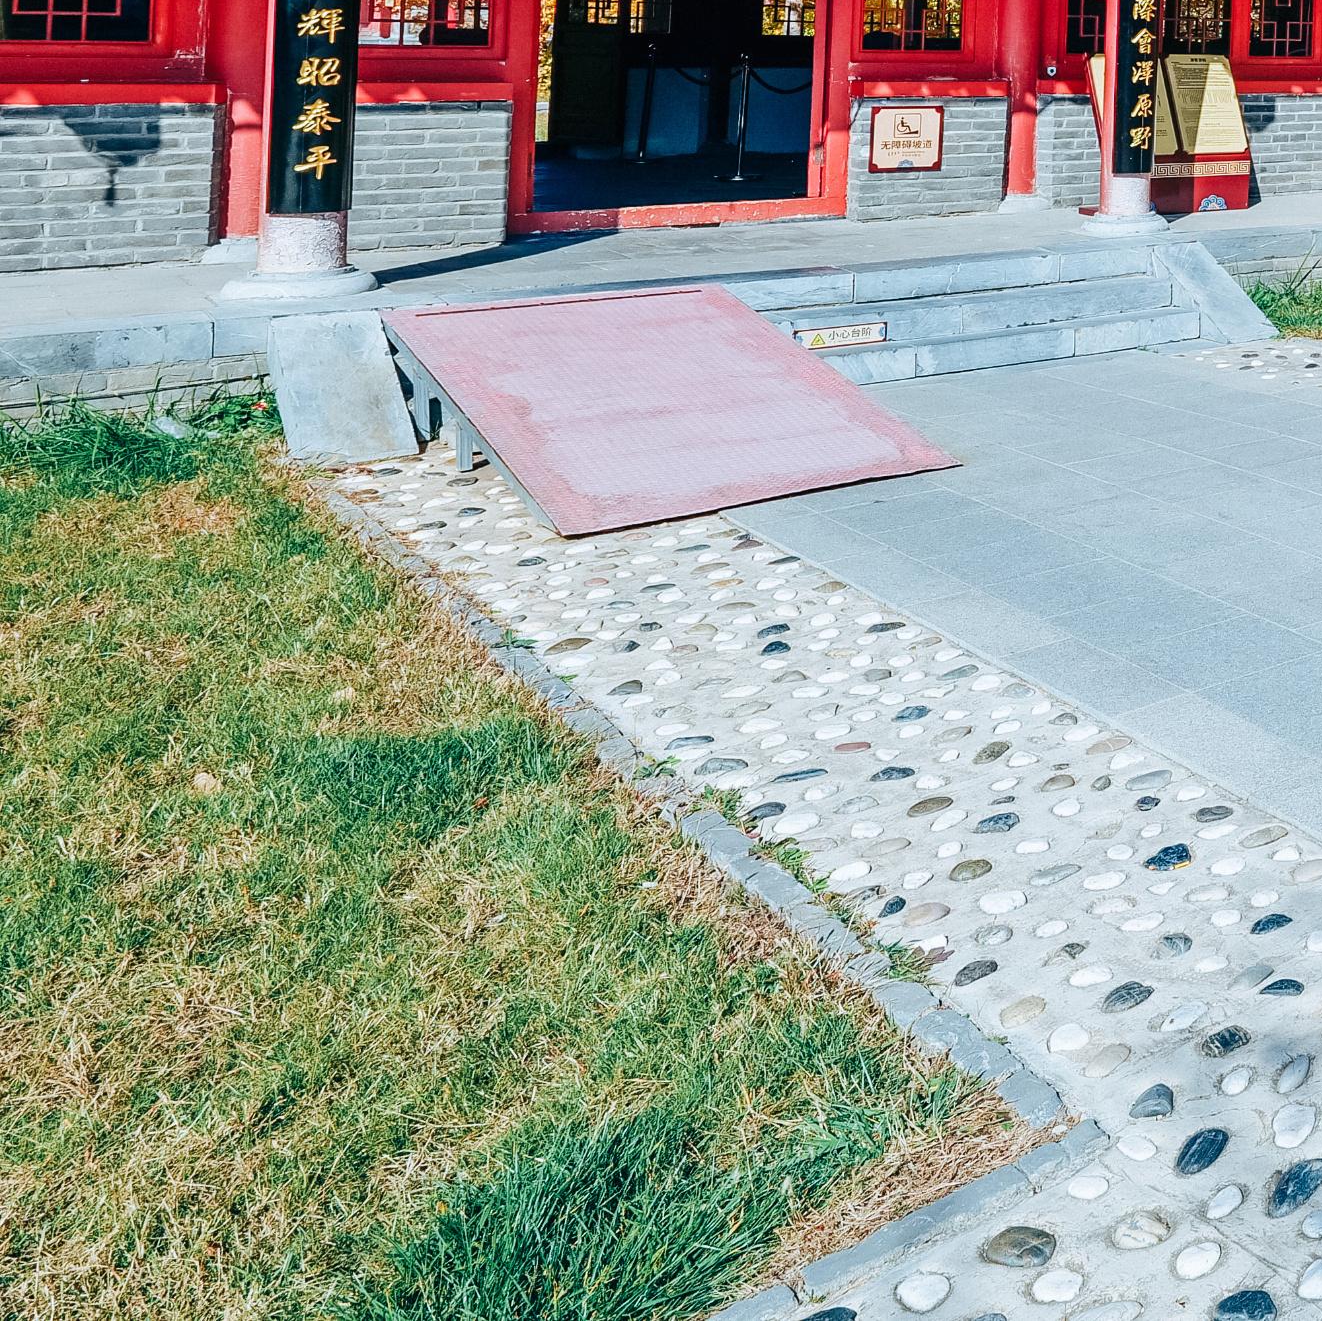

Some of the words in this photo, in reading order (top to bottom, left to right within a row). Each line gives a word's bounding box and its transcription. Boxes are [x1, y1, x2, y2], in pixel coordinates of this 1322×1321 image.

[880, 139, 933, 150] 无障碍坡道
[828, 326, 873, 340] 小心台阶
